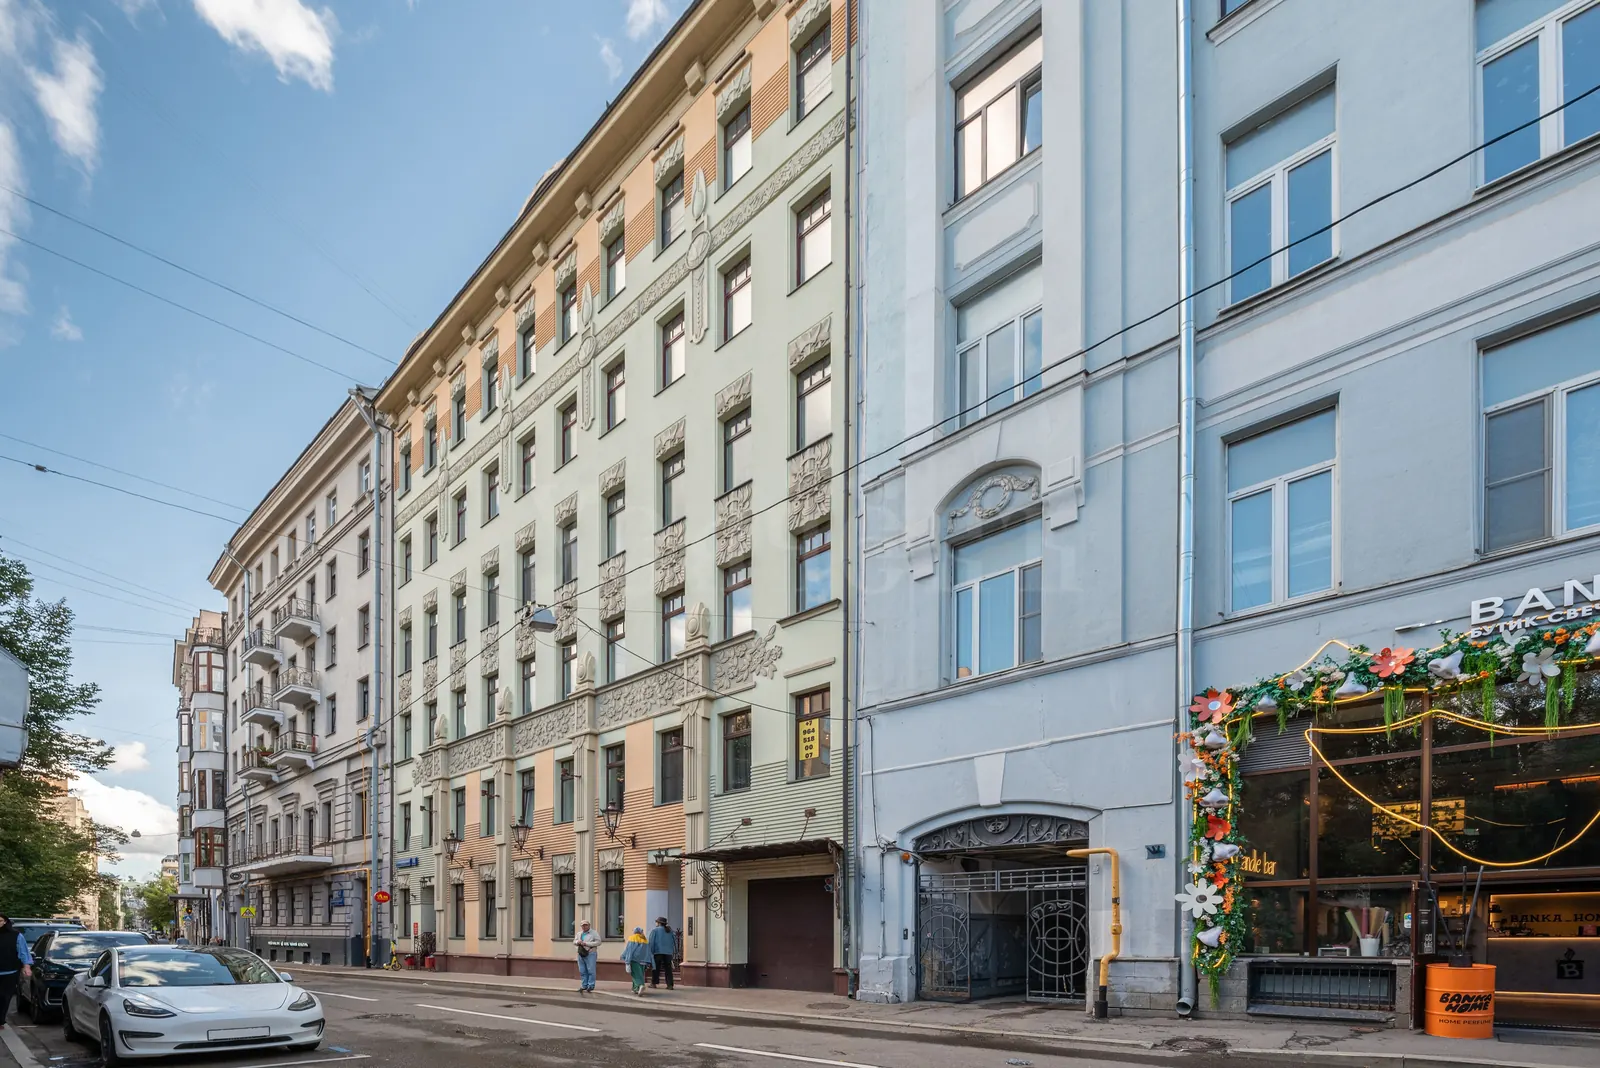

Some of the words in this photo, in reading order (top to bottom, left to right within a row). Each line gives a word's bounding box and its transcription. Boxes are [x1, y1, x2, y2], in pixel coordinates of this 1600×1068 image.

[1471, 574, 1600, 625] BAN
[1471, 615, 1538, 639] БУТИК
[1264, 851, 1276, 875] bar
[1560, 963, 1579, 977] B
[1439, 993, 1492, 1003] BANKA
[1445, 1001, 1490, 1013] HOME
